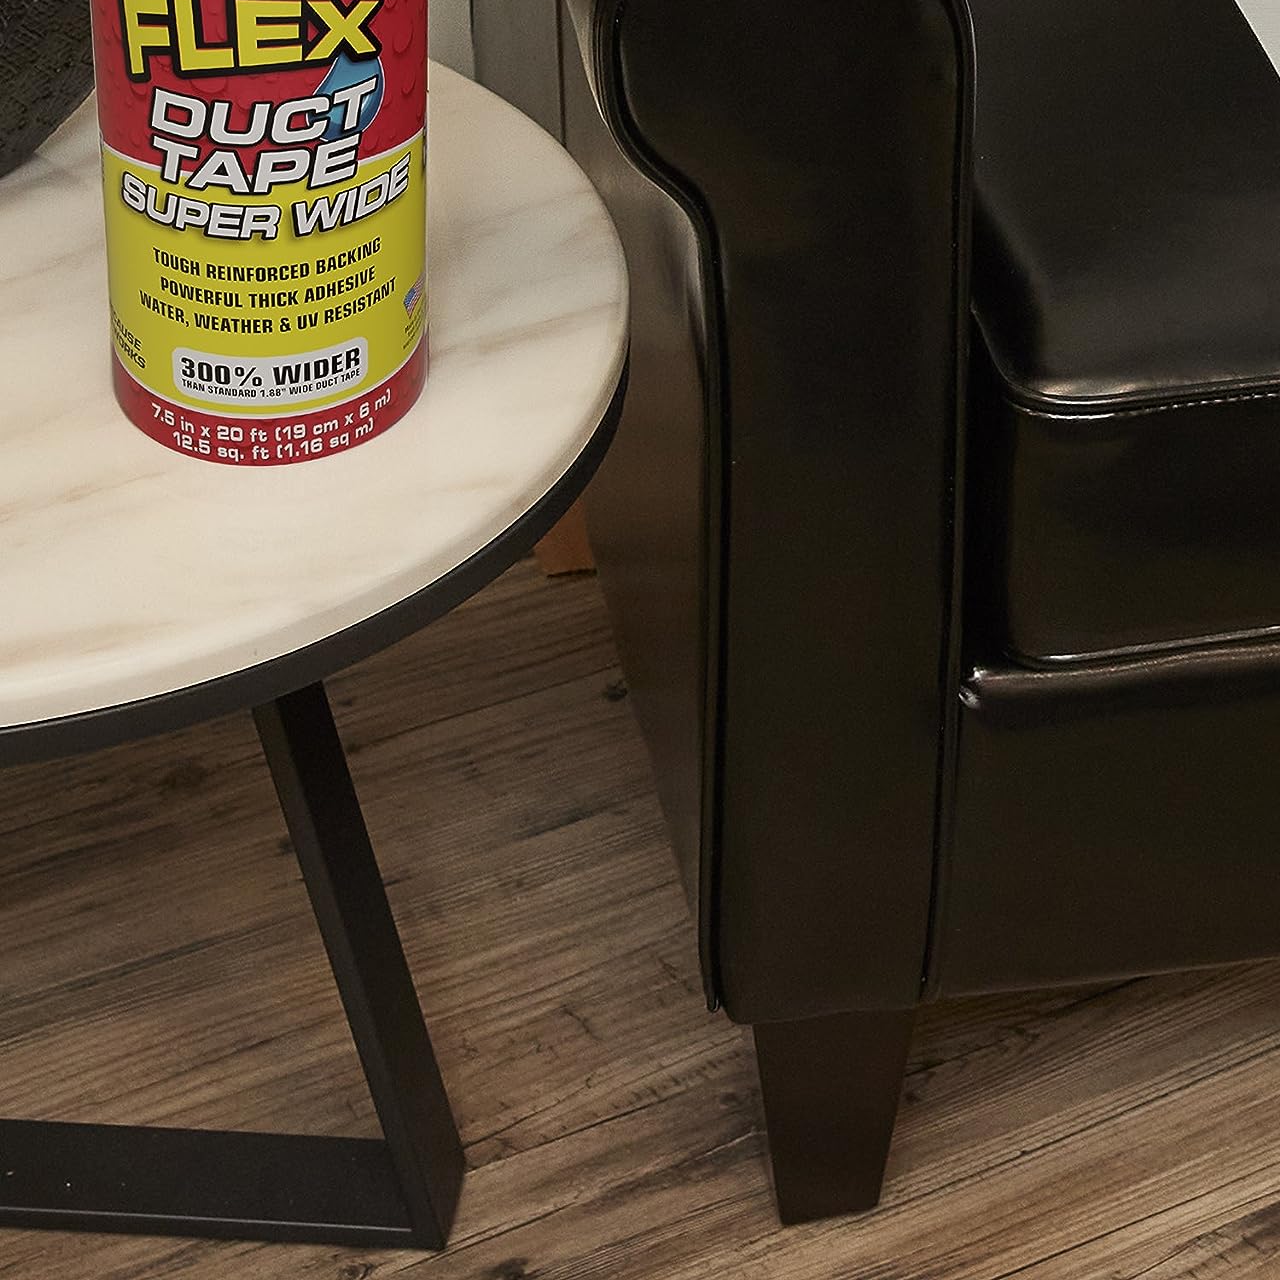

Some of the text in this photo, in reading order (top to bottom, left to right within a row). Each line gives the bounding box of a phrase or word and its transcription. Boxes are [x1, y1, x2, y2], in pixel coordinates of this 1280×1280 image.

[151, 76, 379, 146] DUCT
[151, 133, 362, 195] TAPE
[121, 151, 412, 239] SUPER WIDE
[153, 237, 381, 282] TOUGH REINFORCED BACKING
[139, 276, 396, 334] WATER, WEATHER & UV RESISTANT
[160, 266, 376, 308] POWERFUL THICK ADHESIVE
[180, 347, 360, 387] 300% WIDER
[181, 378, 206, 393] THAN
[207, 385, 257, 398] STANDARD
[289, 383, 313, 397] WIDE
[316, 376, 339, 391] DUCT
[340, 368, 360, 383] TAPE
[151, 402, 175, 426] 7.5
[180, 416, 195, 433] in
[201, 426, 211, 438] x
[217, 425, 243, 442] 20
[250, 428, 267, 442] ft
[313, 420, 339, 435] cm
[344, 413, 354, 426] x
[359, 402, 369, 417] 6
[173, 431, 211, 455] 12.5
[217, 447, 244, 462] sq.
[252, 445, 270, 459] ft
[329, 431, 349, 448] sq
